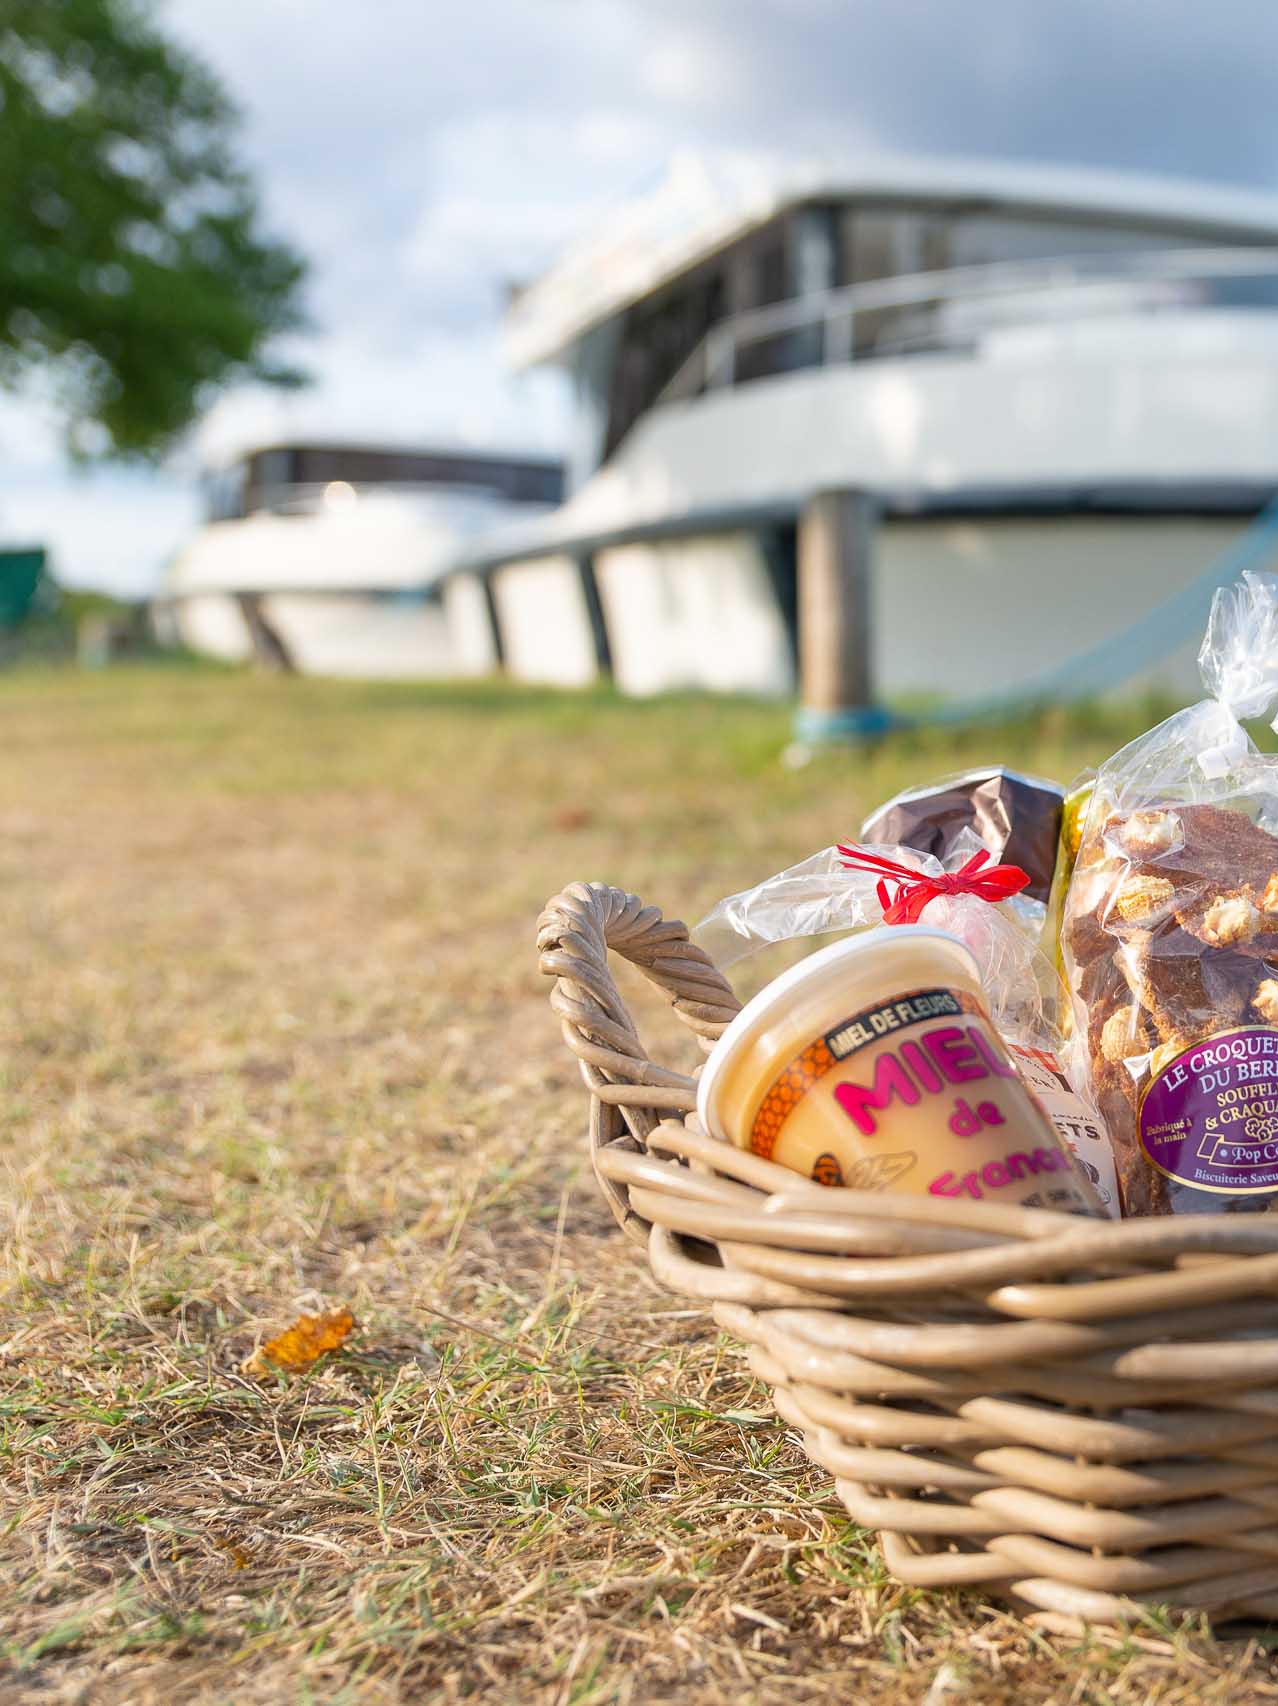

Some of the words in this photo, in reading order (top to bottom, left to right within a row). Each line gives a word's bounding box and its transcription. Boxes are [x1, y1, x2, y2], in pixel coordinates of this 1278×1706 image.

[828, 1022, 875, 1059] MIEL
[869, 1008, 900, 1034] DE
[895, 993, 958, 1022] FLEURS
[833, 1025, 1020, 1136] MIEL
[1162, 1064, 1189, 1092] LE
[1200, 1066, 1231, 1094] DU
[947, 1098, 1006, 1138] de
[1205, 1117, 1219, 1131] &
[1164, 1131, 1187, 1143] main
[1231, 1145, 1261, 1163] Pop
[1194, 1167, 1248, 1184] Biscuiterie
